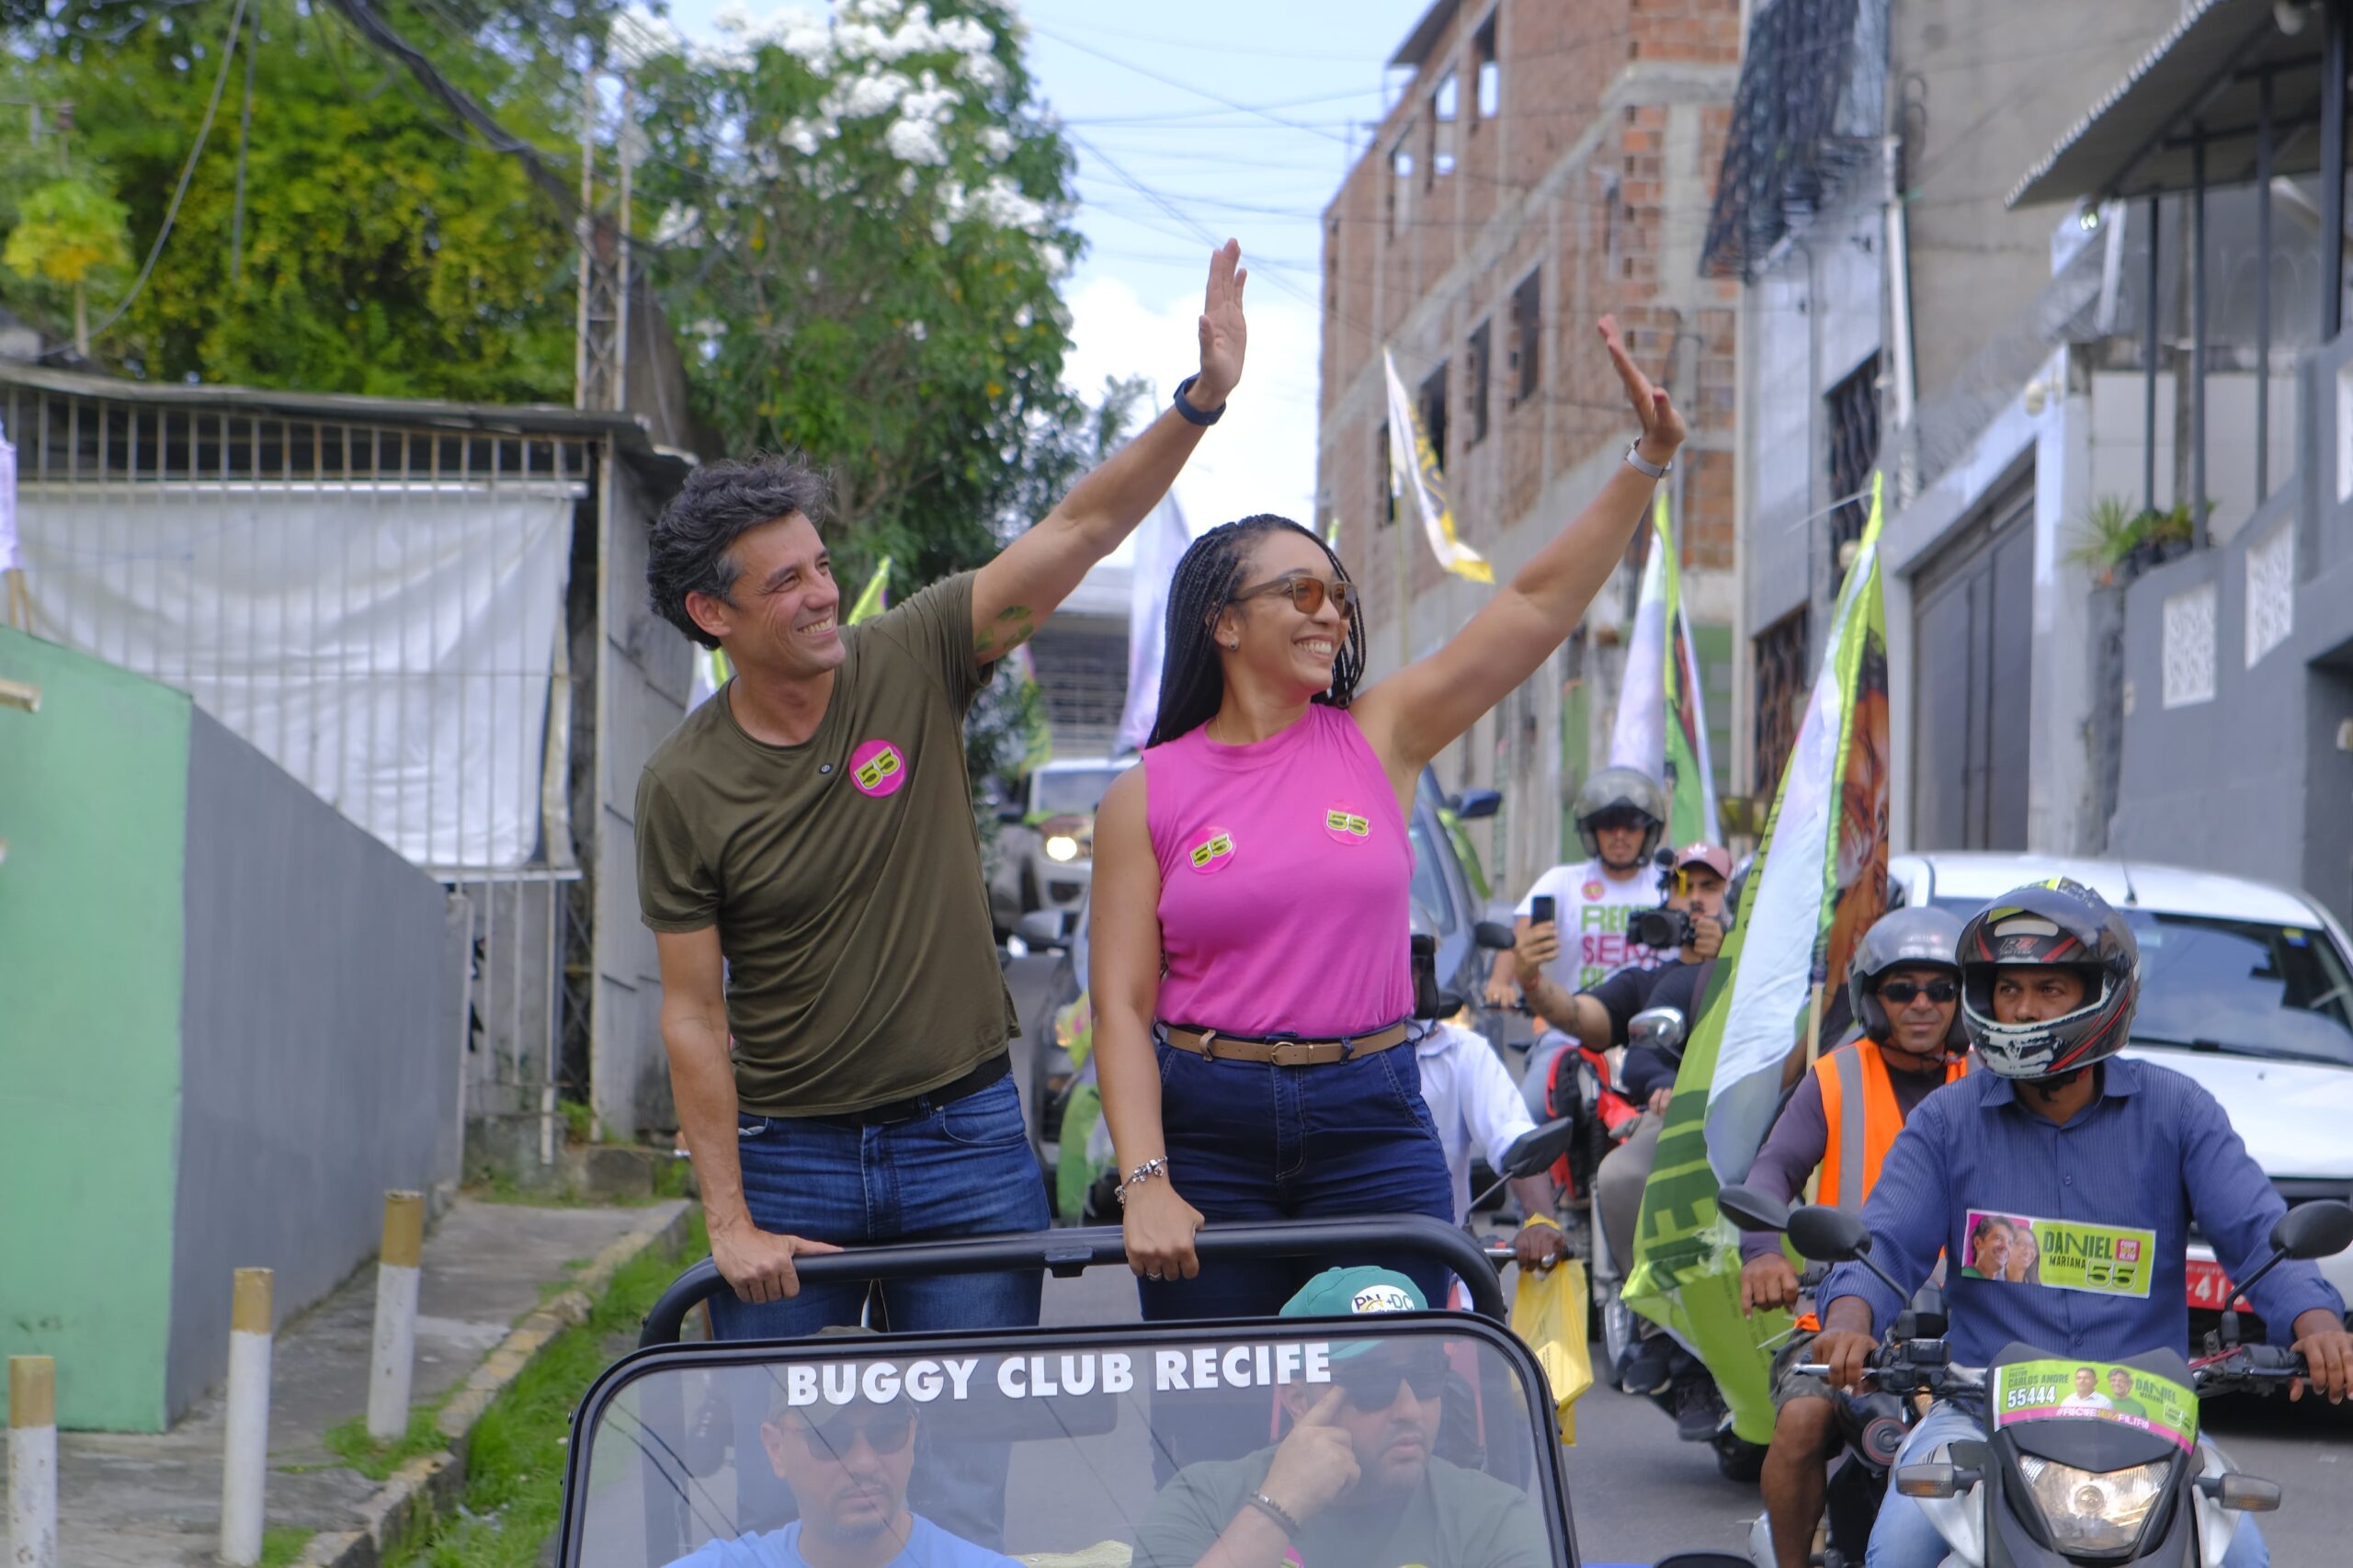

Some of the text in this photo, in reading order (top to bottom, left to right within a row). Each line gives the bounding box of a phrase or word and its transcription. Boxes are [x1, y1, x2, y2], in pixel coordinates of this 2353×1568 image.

[854, 746, 901, 790] 55
[1326, 809, 1369, 836] 55
[1190, 833, 1233, 868] 55
[2042, 1230, 2112, 1260] DANIEL
[2049, 1255, 2086, 1270] MARIANA
[2086, 1258, 2137, 1290] 55
[788, 1342, 1332, 1407] BUGGY CLUB RECIFE
[2007, 1374, 2039, 1388] CARLOS
[2007, 1383, 2057, 1409] 55444
[2136, 1379, 2177, 1404] DANIEL
